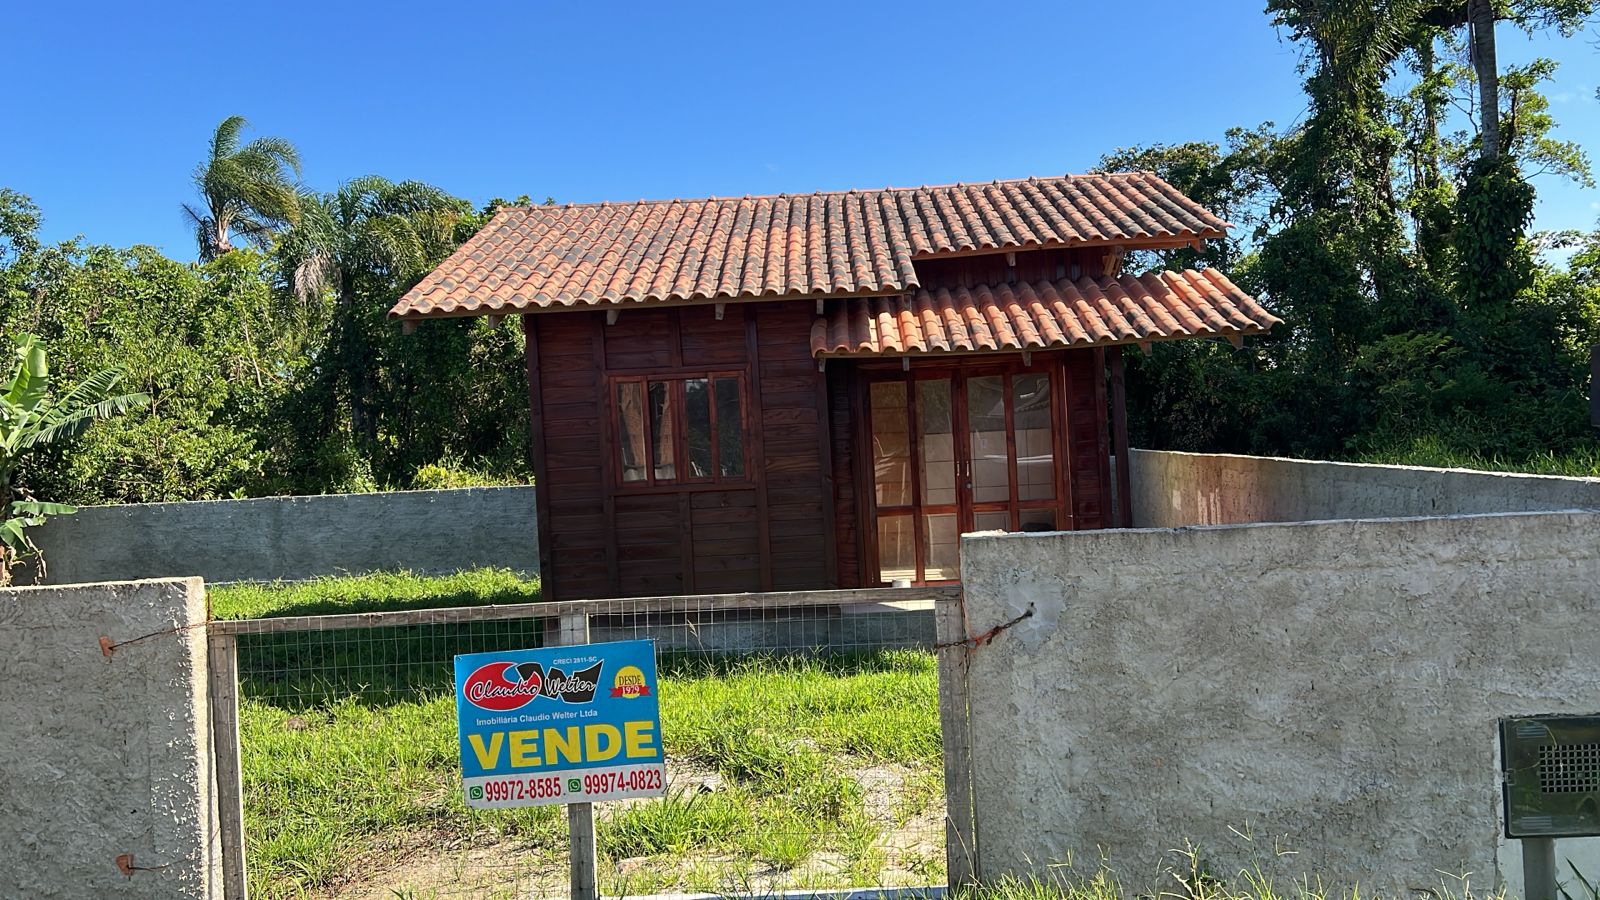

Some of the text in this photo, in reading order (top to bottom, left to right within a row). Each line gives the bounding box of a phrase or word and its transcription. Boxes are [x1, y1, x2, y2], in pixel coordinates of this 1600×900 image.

[470, 675, 596, 702] Claudio Welter
[619, 674, 641, 686] DESDE
[622, 685, 640, 695] 1979
[520, 713, 550, 722] Claudio
[552, 711, 577, 720] Welter
[580, 709, 597, 718] Ltda
[468, 721, 657, 770] VENDE
[486, 770, 662, 801] 99972-8585 99974-0823
